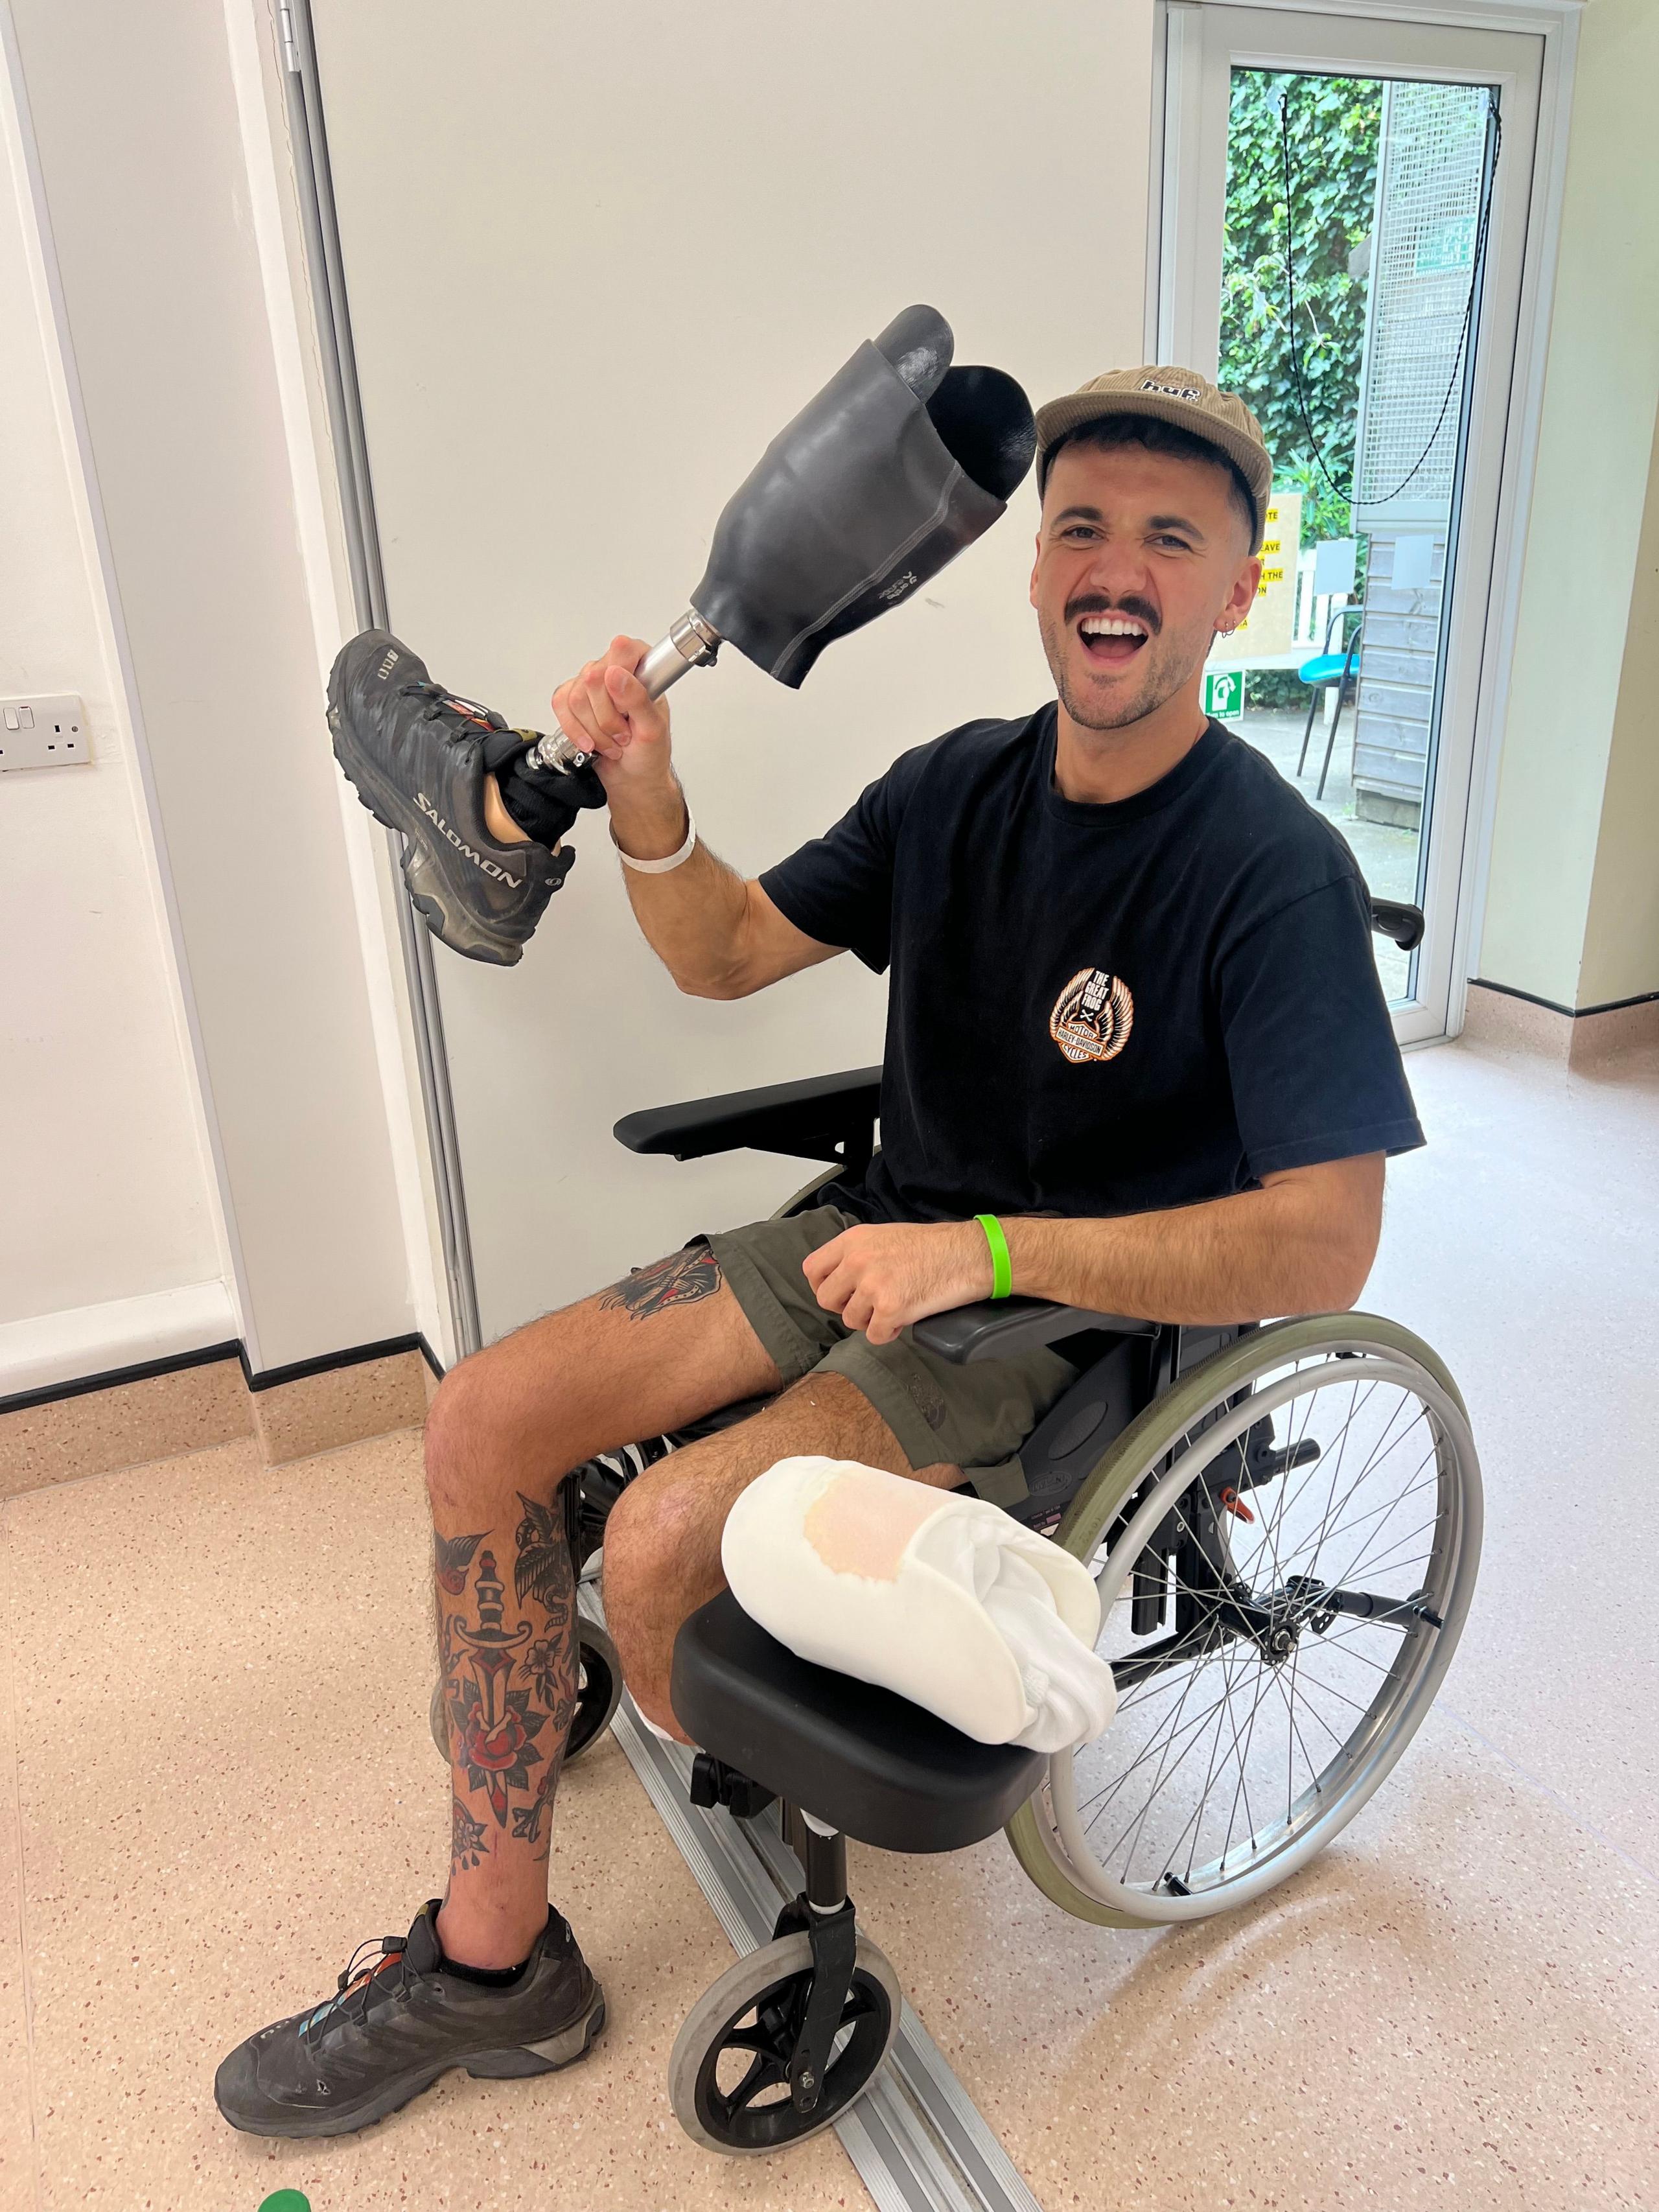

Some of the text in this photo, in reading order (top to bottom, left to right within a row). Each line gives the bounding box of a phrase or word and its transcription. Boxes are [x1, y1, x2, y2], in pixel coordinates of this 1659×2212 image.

[1141, 379, 1201, 402] huf
[412, 792, 524, 889] SALOMON
[1093, 970, 1109, 986] THE
[1084, 981, 1109, 1000] GREAT
[1081, 993, 1103, 1011] FROG
[1069, 1025, 1094, 1038] MOTOR
[1057, 1029, 1102, 1054] HARLEY-DAVIDSON
[1063, 1043, 1087, 1060] CYCLES
